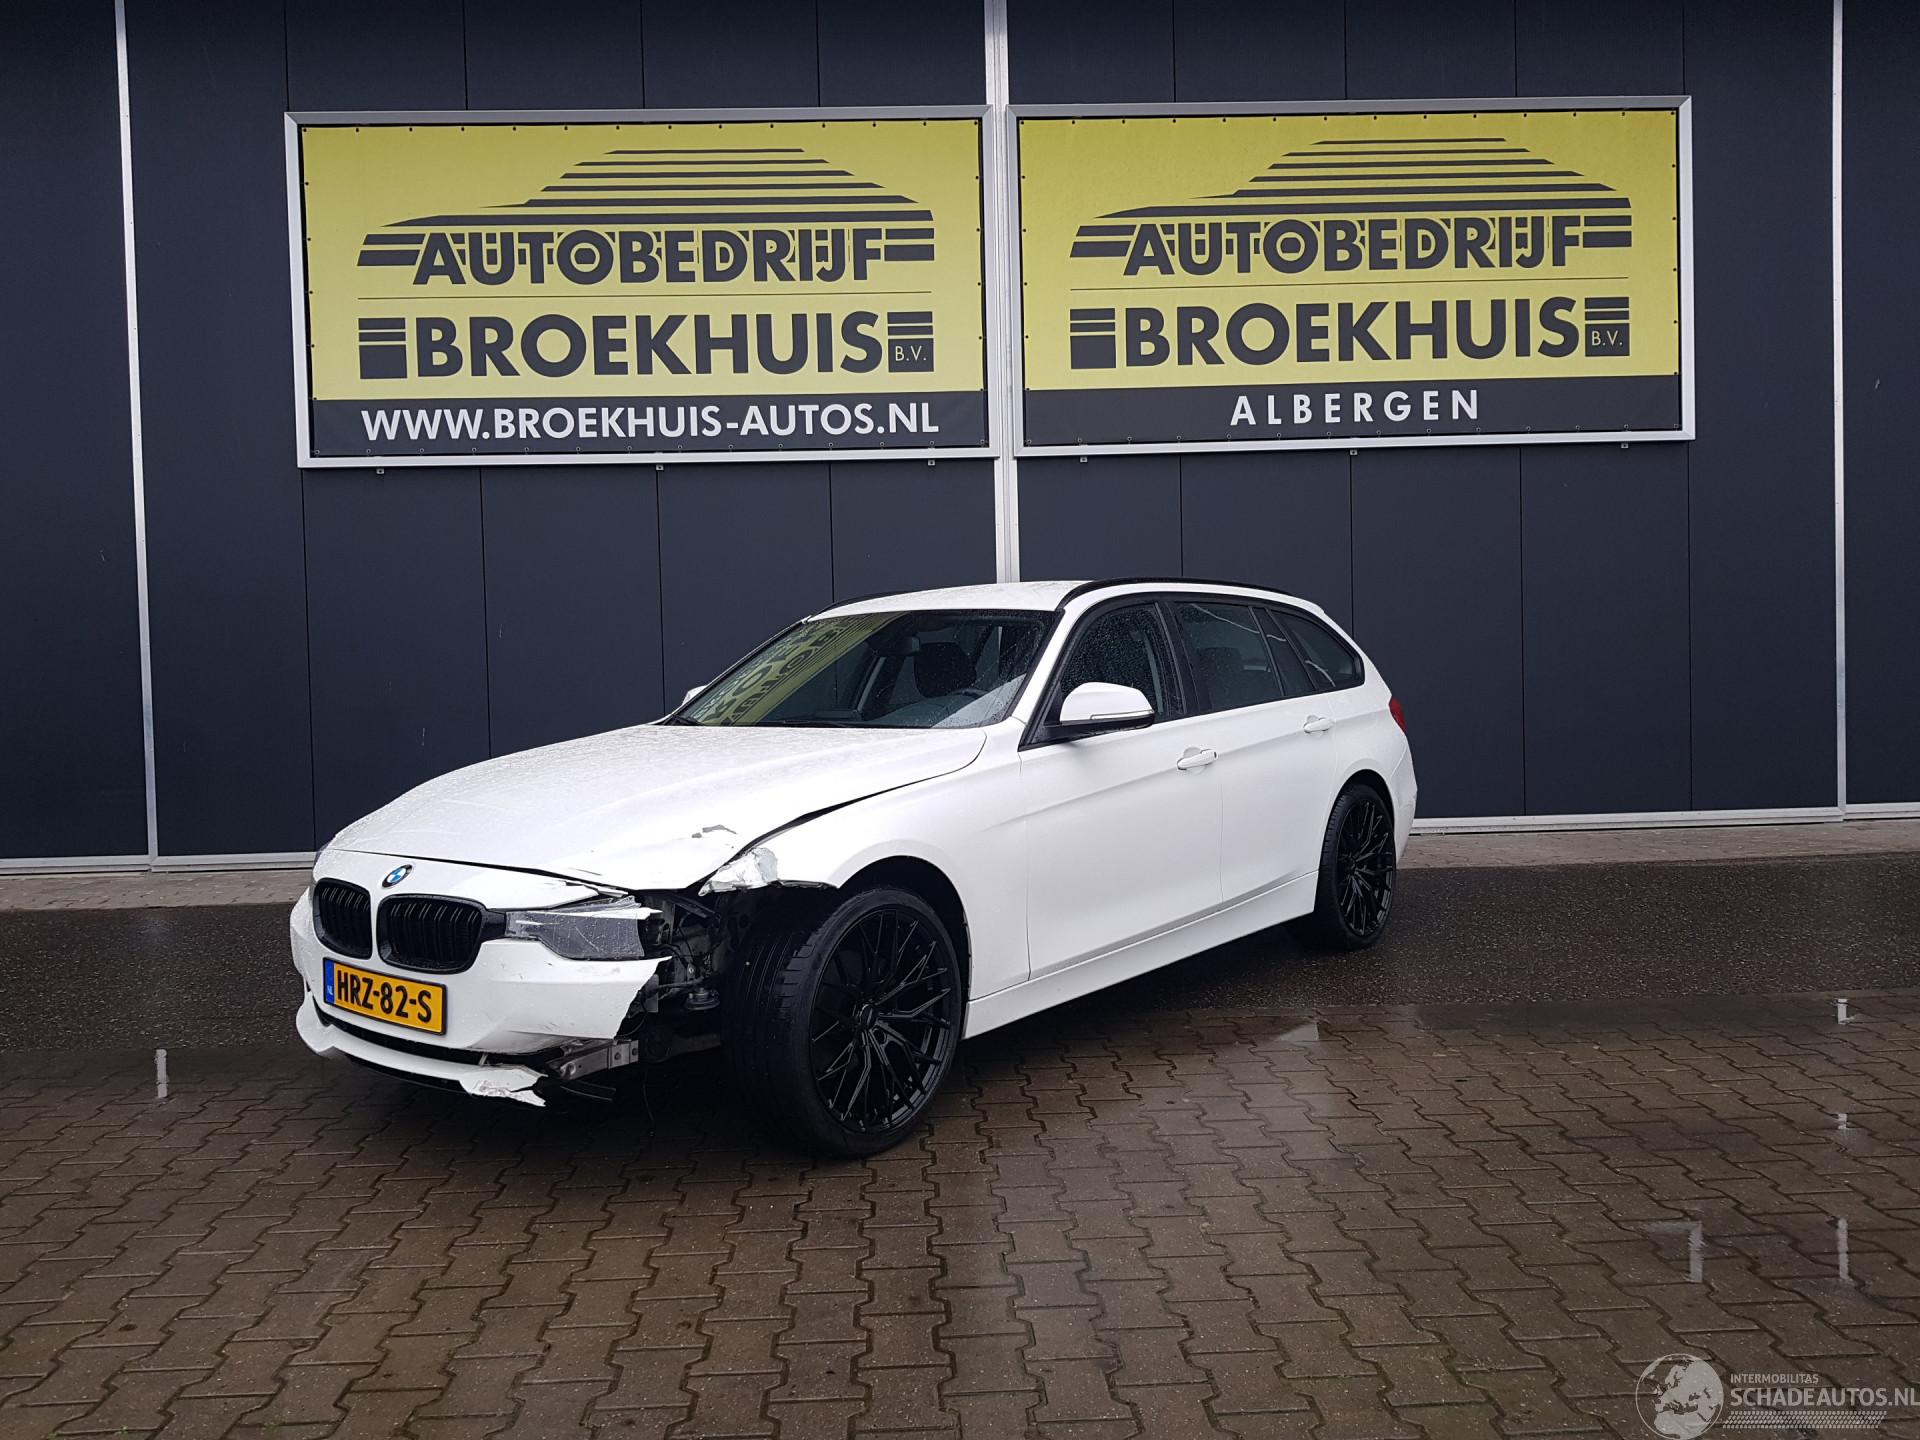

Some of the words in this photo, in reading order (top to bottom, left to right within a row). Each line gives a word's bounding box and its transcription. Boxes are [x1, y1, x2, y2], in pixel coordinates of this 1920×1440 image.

[413, 228, 882, 285] AUTOBEDRIJF
[1123, 216, 1581, 275] AUTOBEDRIJF
[416, 311, 883, 378] BROEKHUIS
[895, 345, 927, 361] B.V.
[1125, 296, 1580, 367] BROEKHUIS
[1591, 331, 1624, 347] B.V.
[361, 403, 939, 441] WWW.BROEKHUIS-AUTOS.NL
[1230, 389, 1479, 426] ALBERGEN
[337, 969, 432, 1023] HRZ-82-S
